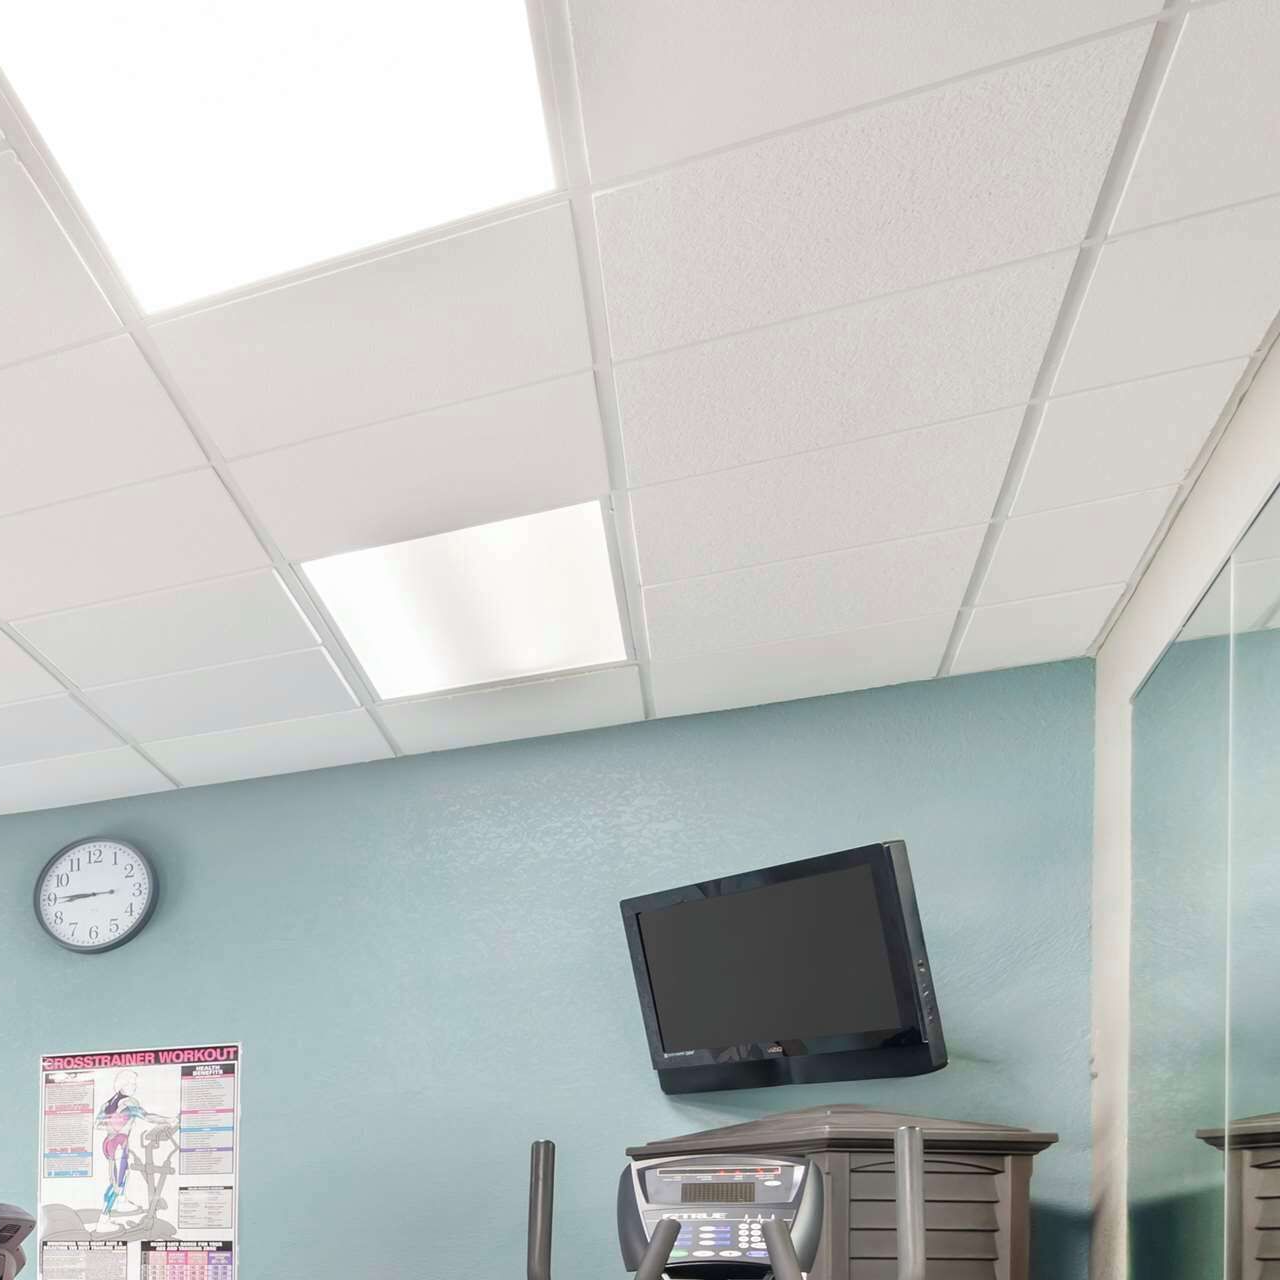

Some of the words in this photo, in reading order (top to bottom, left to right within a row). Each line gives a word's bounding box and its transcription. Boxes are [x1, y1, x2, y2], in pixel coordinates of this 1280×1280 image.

[87, 848, 103, 864] 12
[112, 851, 118, 865] 1
[69, 858, 81, 872] 11
[124, 864, 135, 878] 2
[55, 873, 70, 888] 10
[132, 882, 143, 897] 3
[47, 892, 57, 907] 9
[125, 902, 134, 916] 4
[54, 911, 64, 925] 8
[109, 918, 119, 933] 5
[69, 922, 78, 937] 7
[89, 925, 99, 940] 6
[44, 1052, 155, 1070] CROSSTRAINER
[159, 1047, 237, 1063] WORKOUT
